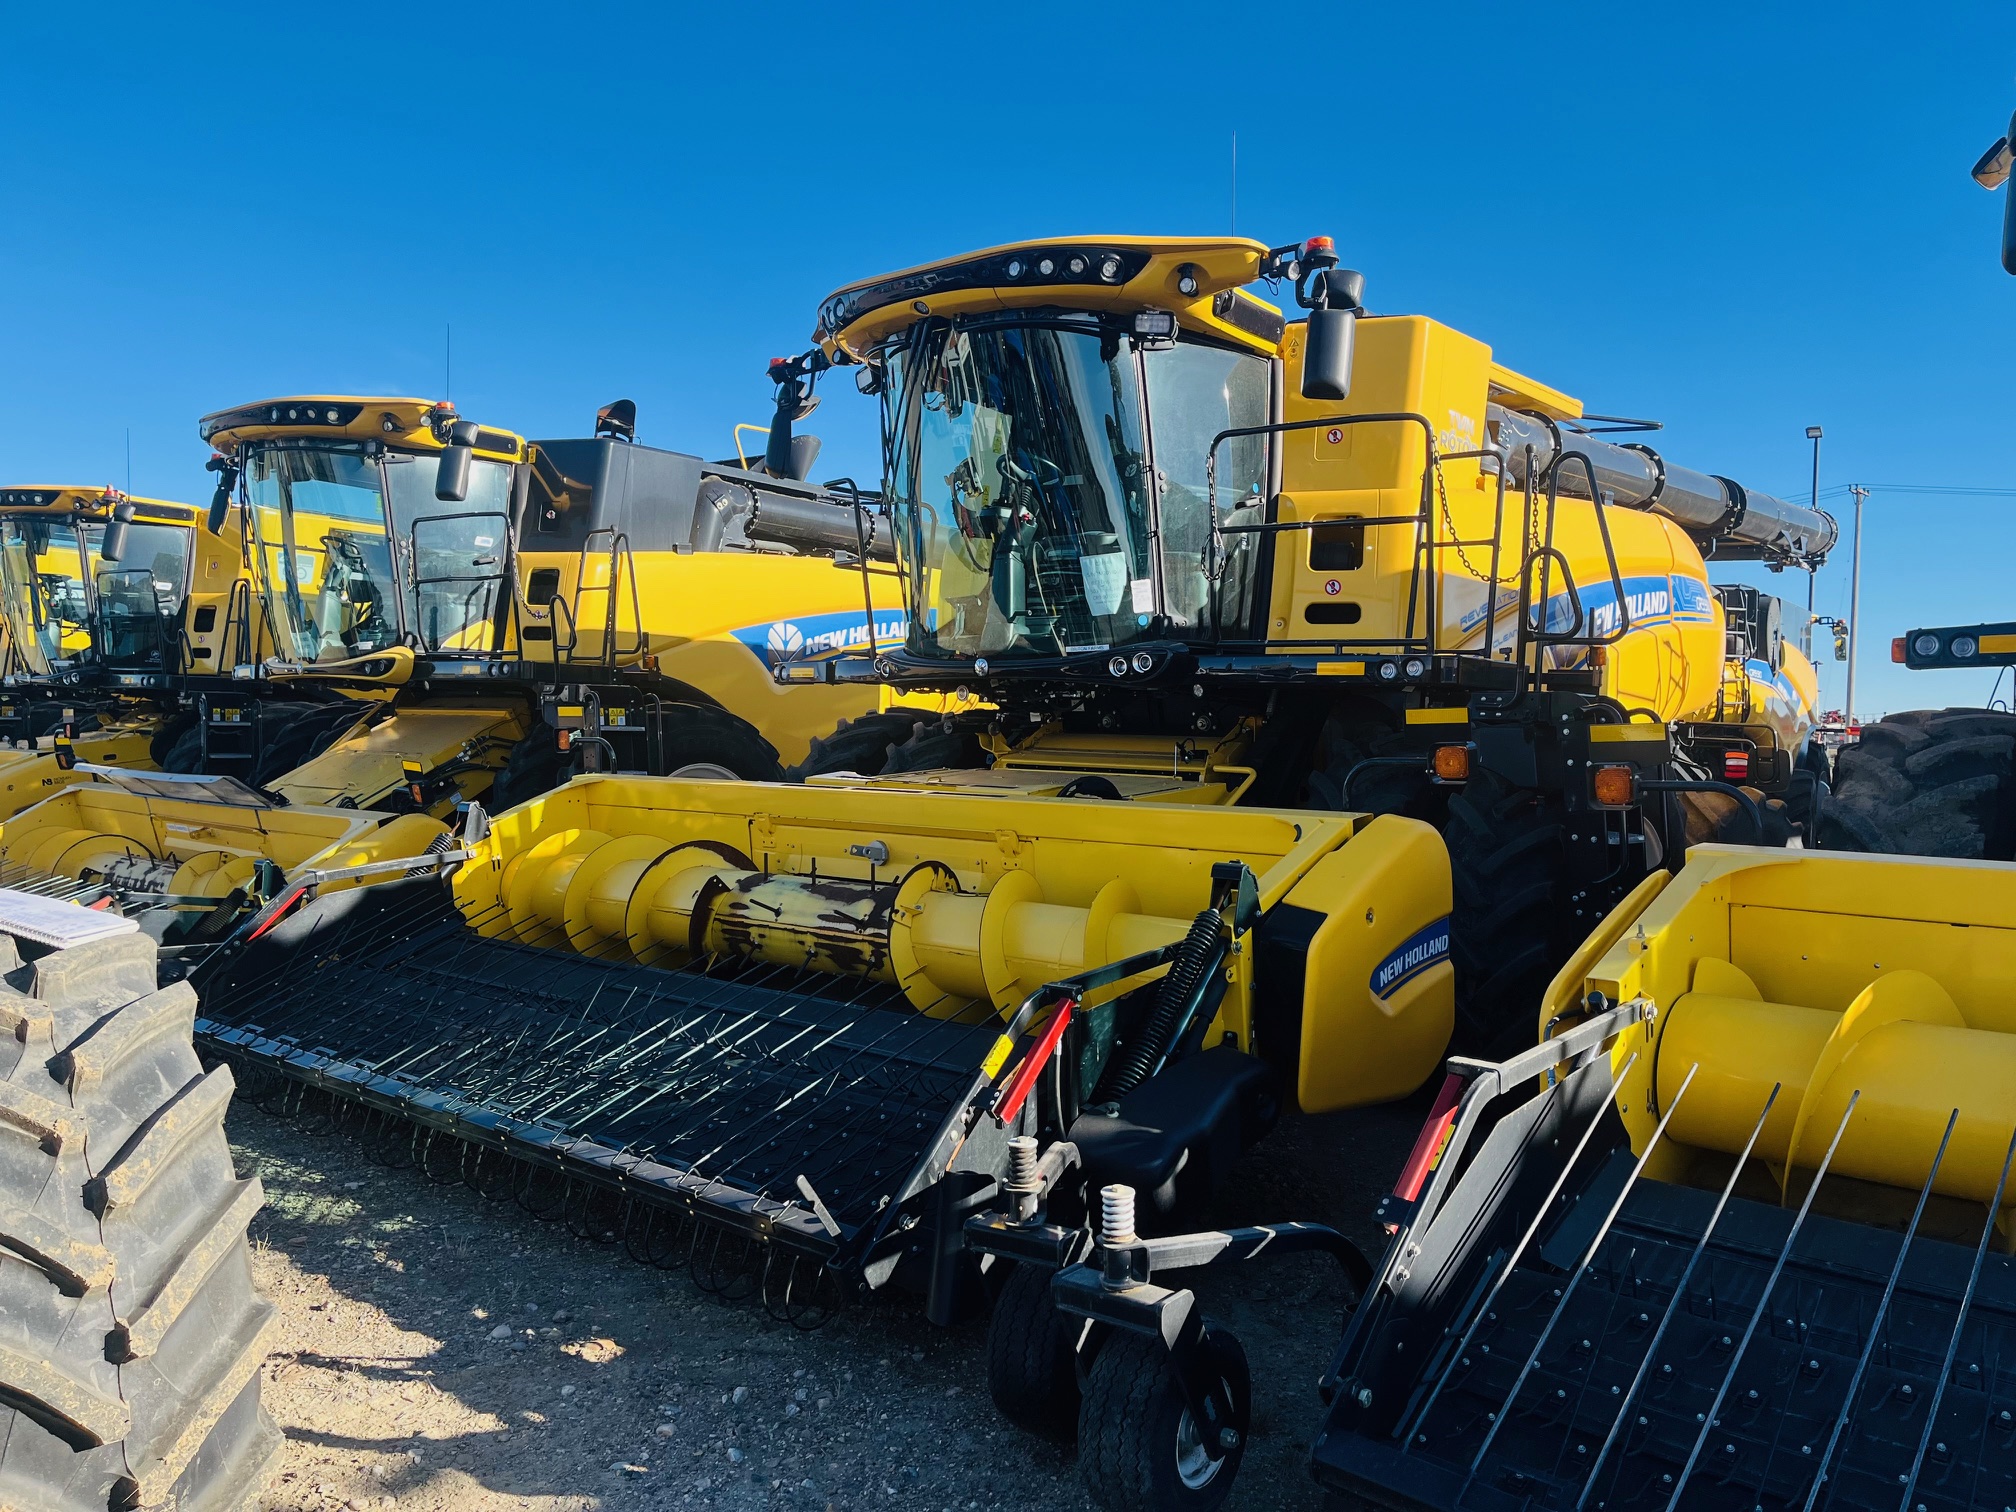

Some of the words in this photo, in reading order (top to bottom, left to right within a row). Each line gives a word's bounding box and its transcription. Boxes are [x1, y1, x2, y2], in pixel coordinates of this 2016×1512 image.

[1460, 591, 1519, 626] REVEATIO
[806, 629, 847, 655] NEW
[1380, 956, 1403, 987] NEW
[1405, 934, 1448, 969] HOLLAND
